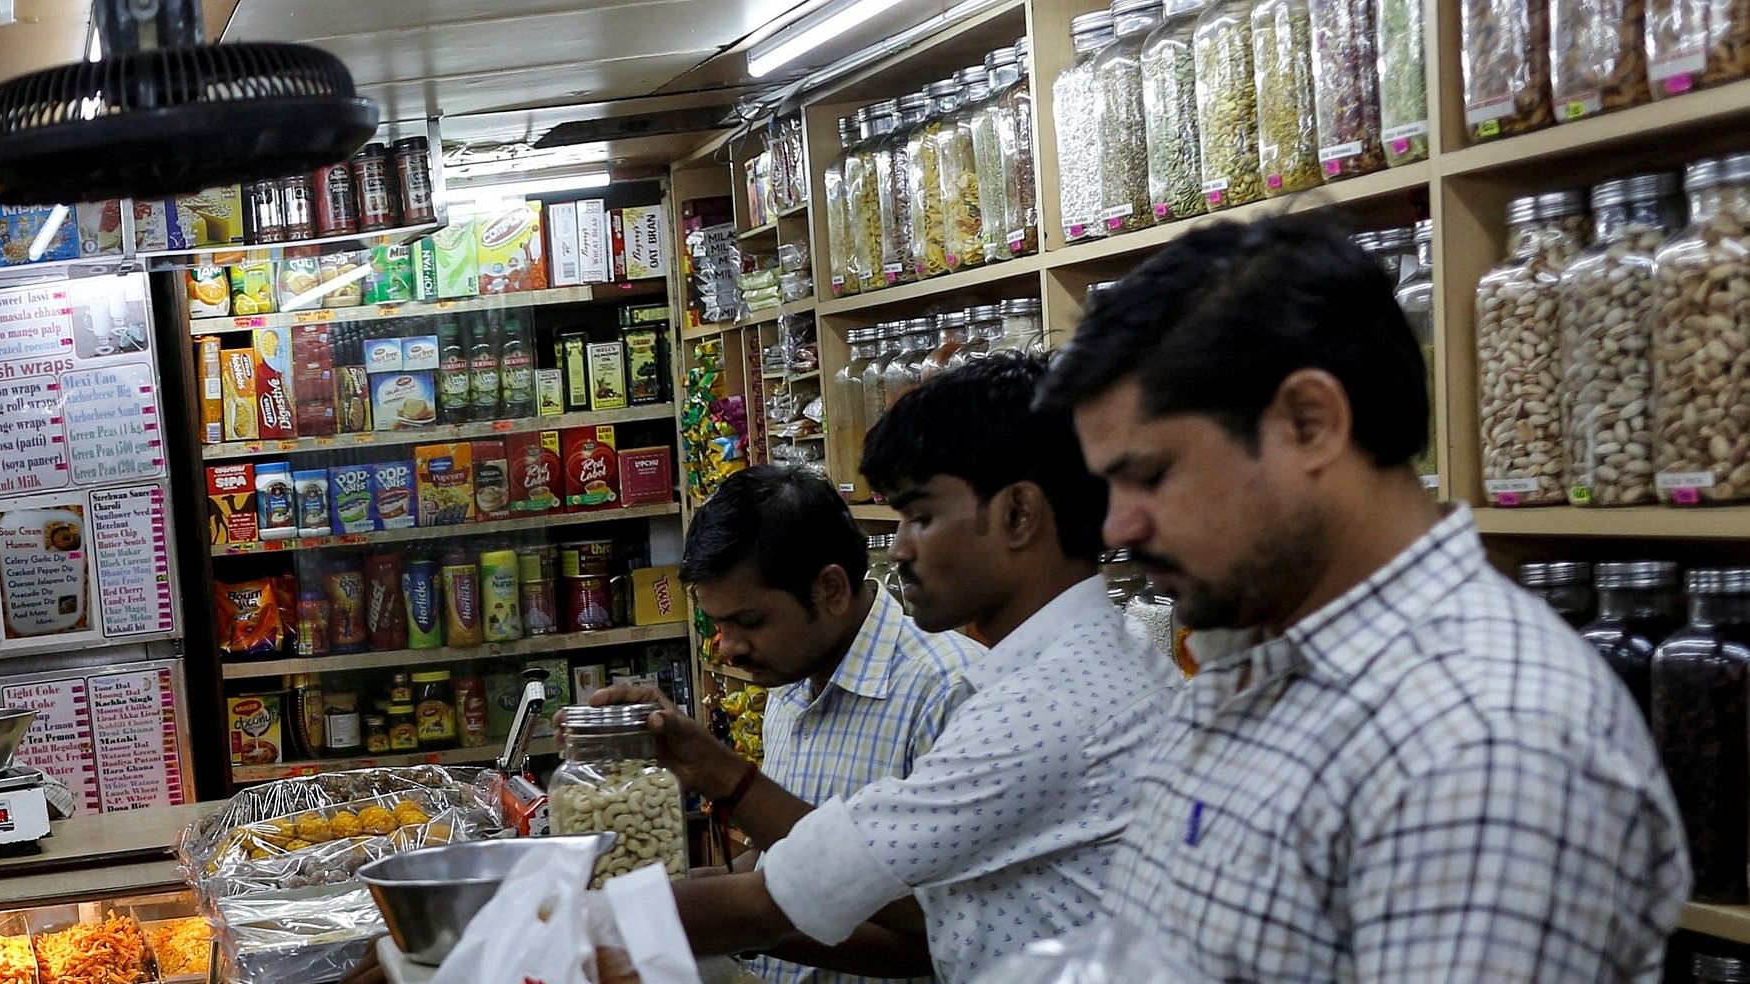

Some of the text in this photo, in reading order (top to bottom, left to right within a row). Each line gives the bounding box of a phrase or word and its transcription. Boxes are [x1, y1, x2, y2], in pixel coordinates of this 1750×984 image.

[28, 292, 49, 302] lassi
[0, 310, 32, 322] masala
[8, 327, 38, 340] mango
[20, 358, 74, 378] wraps
[11, 385, 41, 398] wraps
[268, 378, 292, 431] Digestive
[16, 419, 46, 430] wraps
[16, 436, 47, 449] (patti)
[527, 463, 549, 476] Red
[584, 457, 604, 471] Red
[17, 475, 42, 488] Milk
[215, 477, 247, 488] SIPA
[524, 472, 551, 488] Label
[580, 468, 607, 484] Label
[95, 512, 131, 521] Sunflower
[18, 527, 42, 535] Cream
[54, 553, 66, 563] Dip
[228, 590, 262, 602] Bourn
[418, 580, 427, 625] Horlicks
[462, 578, 473, 620] Horlicks
[36, 686, 60, 696] Coke
[45, 722, 73, 731] Lemon
